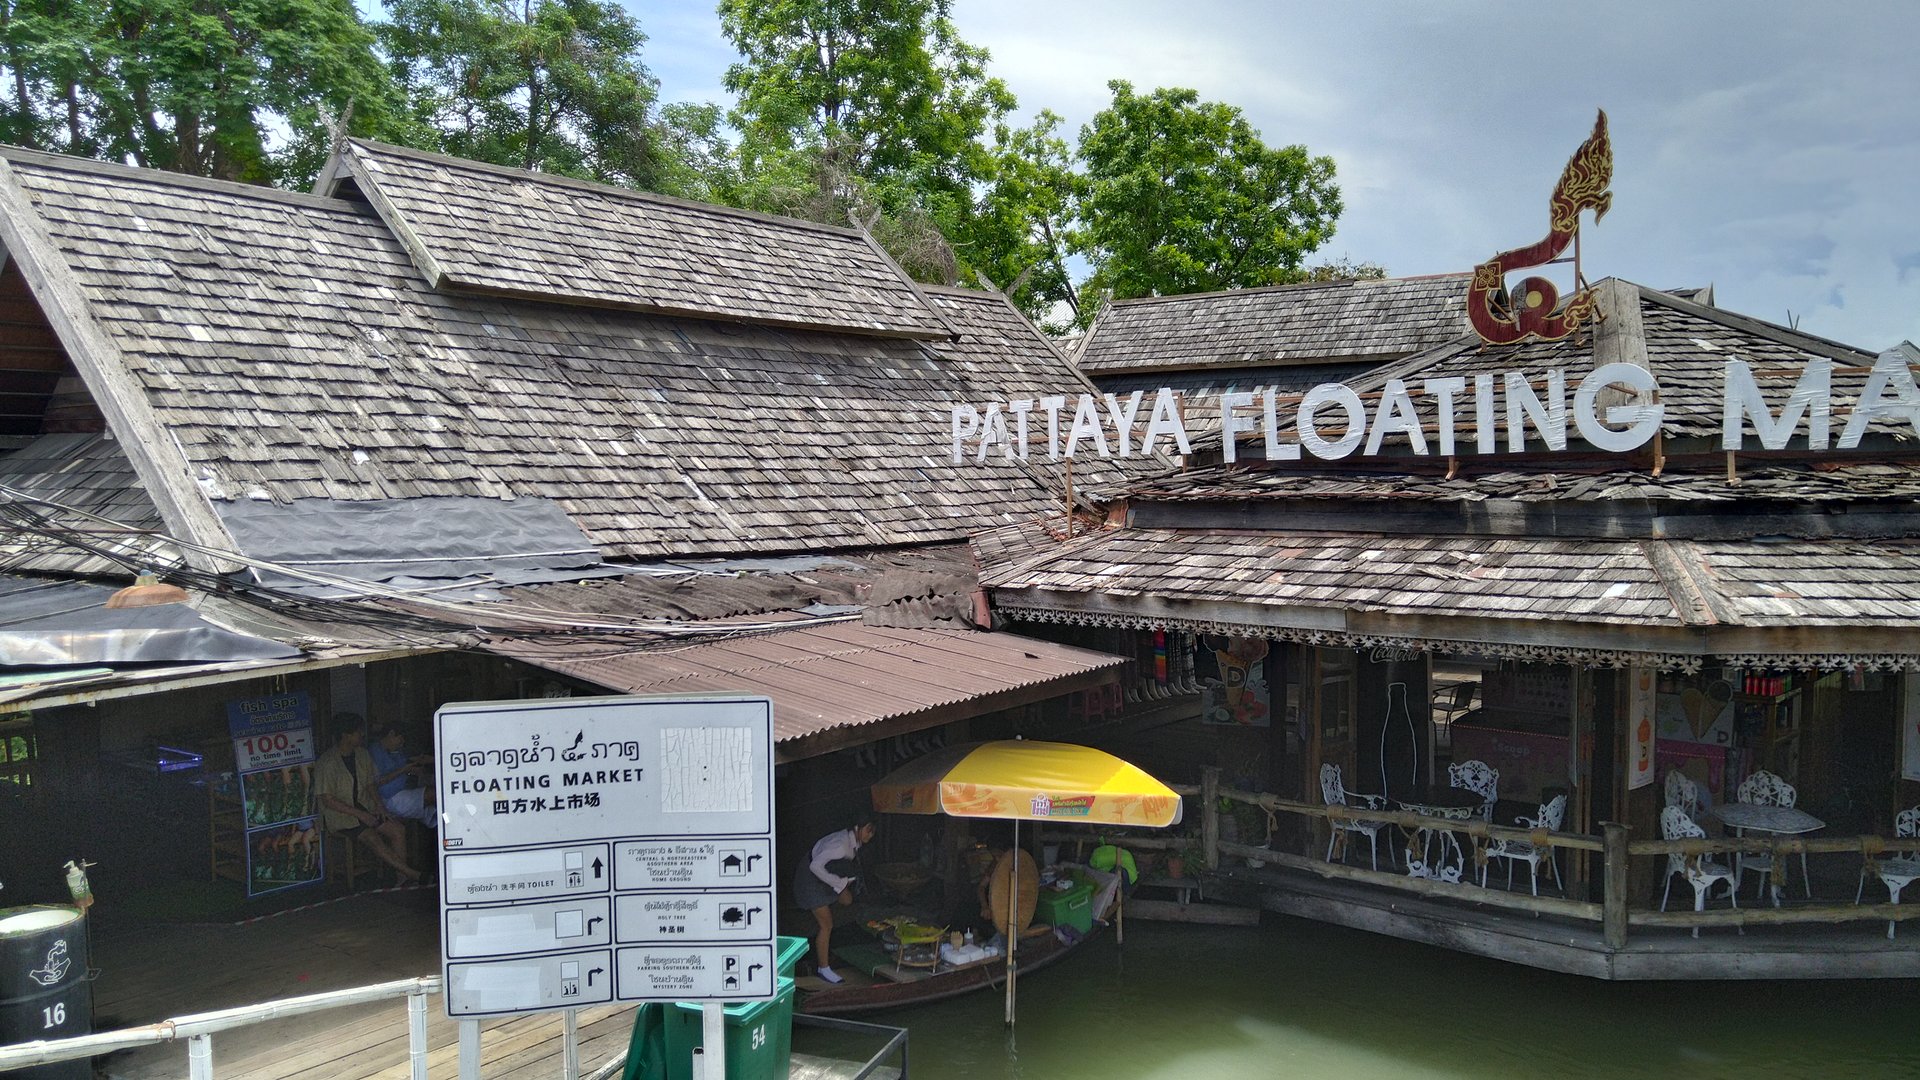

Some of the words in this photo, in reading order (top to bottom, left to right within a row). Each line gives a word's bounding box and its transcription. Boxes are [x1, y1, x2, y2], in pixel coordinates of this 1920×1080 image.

[952, 387, 1192, 463] PATTAYA
[1219, 362, 1665, 464] FLOATING
[1722, 340, 1920, 451] MA
[240, 700, 267, 714] fish
[273, 696, 298, 710] spa
[263, 752, 281, 760] time
[284, 748, 302, 757] limit
[450, 734, 555, 773] ตลาดน้ำ
[591, 741, 640, 762] ภาค
[450, 774, 551, 794] FLOATING
[563, 768, 644, 787] MARKET
[493, 791, 601, 816] 四方水上市场
[528, 880, 554, 889] TOILET
[659, 925, 685, 934] 神圣树
[43, 1002, 66, 1029] 16
[752, 1024, 767, 1051] 54
